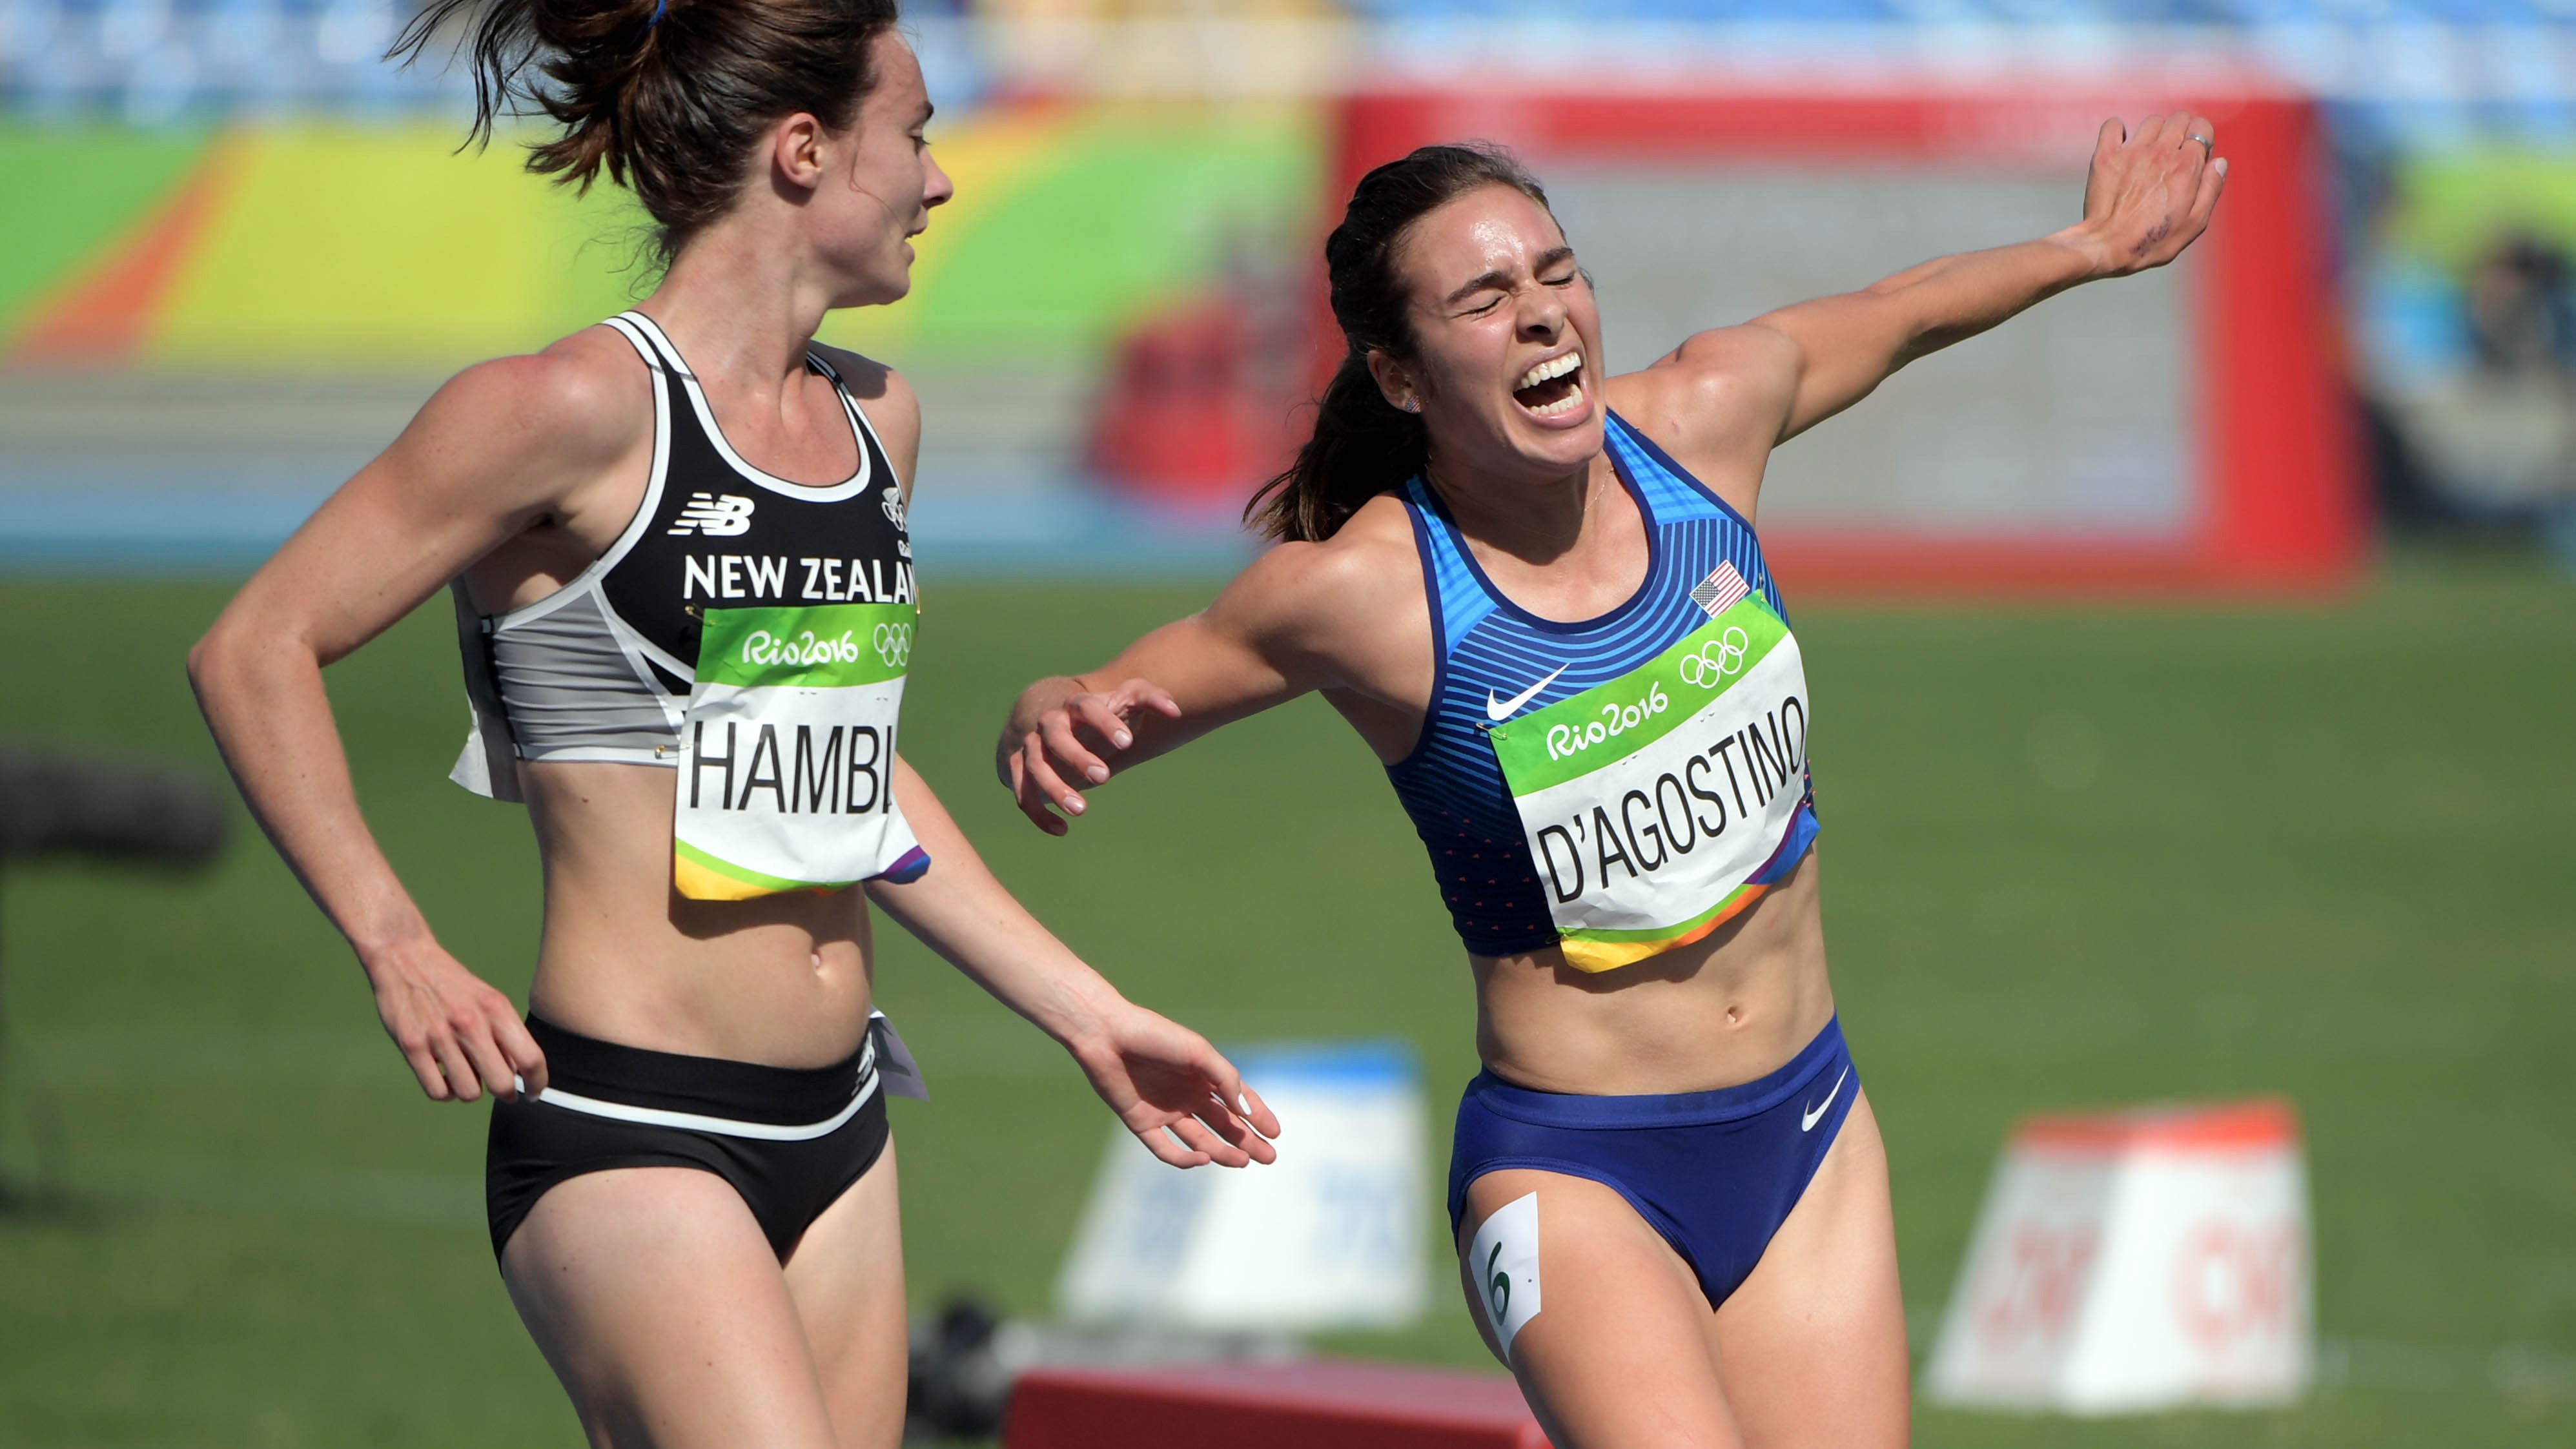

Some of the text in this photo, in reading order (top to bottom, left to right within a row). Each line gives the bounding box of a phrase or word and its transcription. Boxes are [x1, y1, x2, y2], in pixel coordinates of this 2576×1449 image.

[683, 555, 788, 599] NEW
[1537, 695, 1806, 904] D'AGOSTINO
[1487, 1241, 1511, 1326] 6
